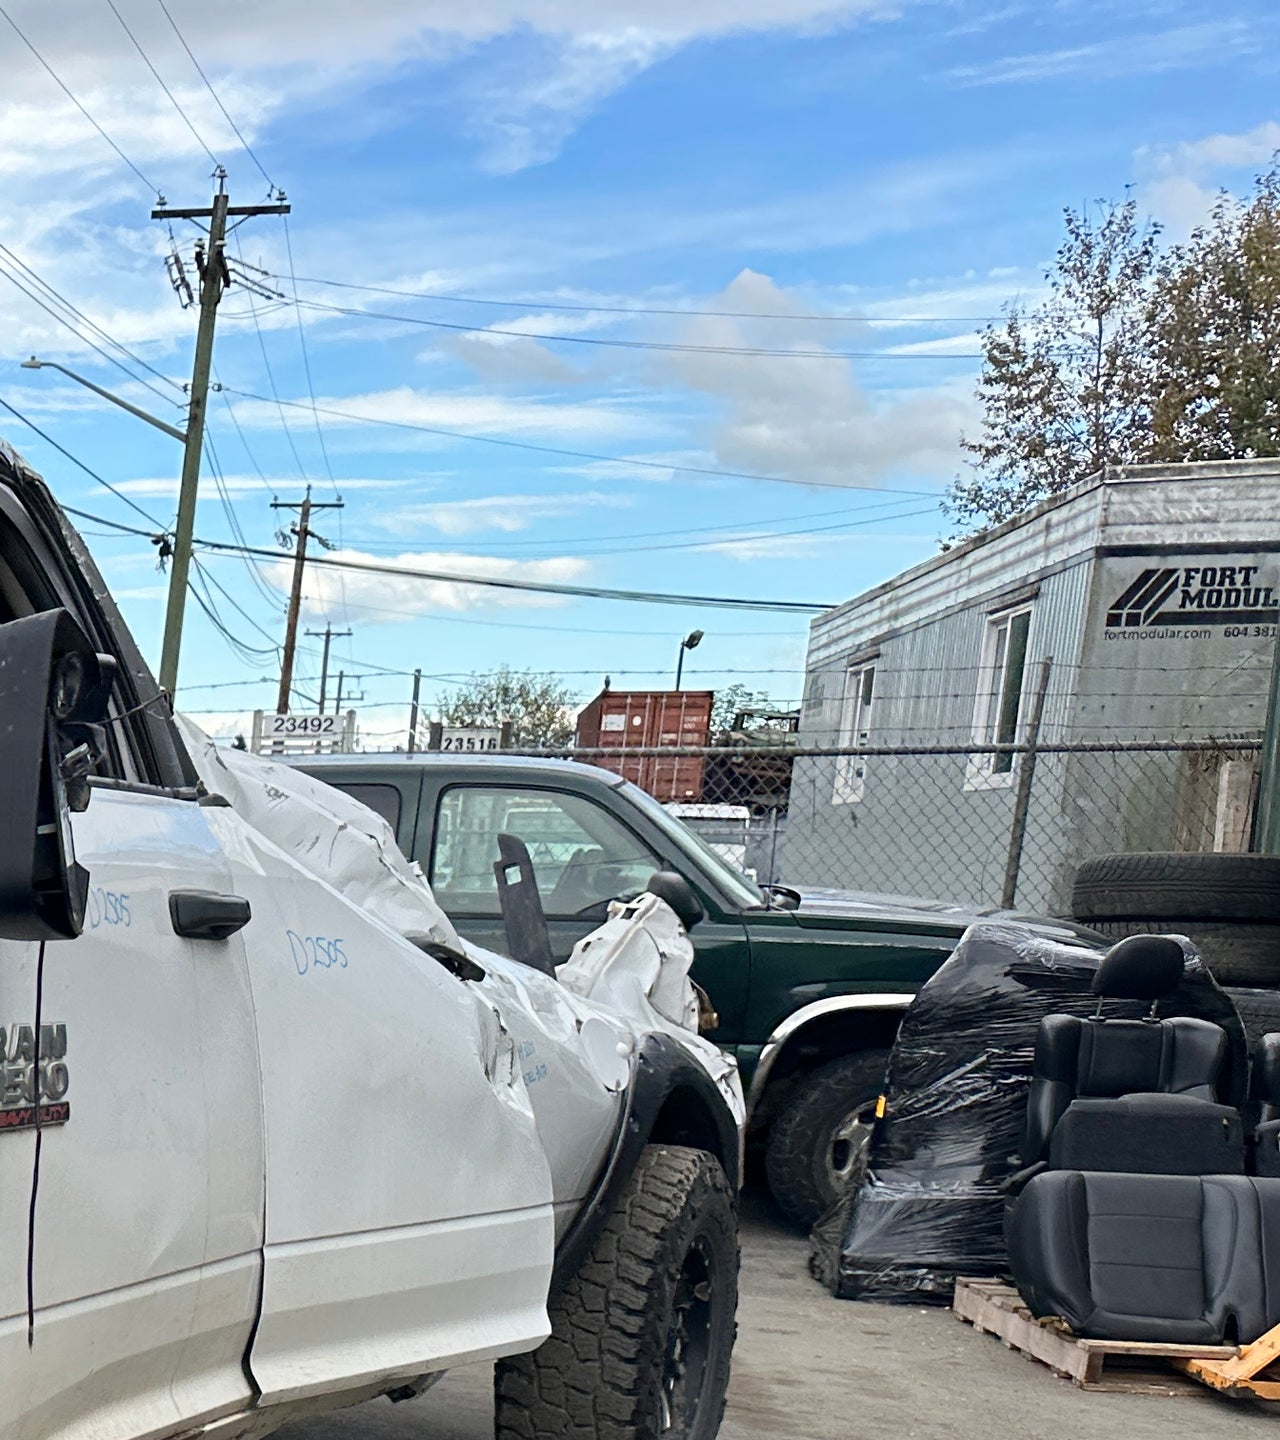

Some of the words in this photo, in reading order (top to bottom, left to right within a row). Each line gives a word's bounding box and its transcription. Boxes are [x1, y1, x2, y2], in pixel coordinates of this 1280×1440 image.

[1181, 566, 1259, 588] FORT
[1104, 627, 1211, 641] fortmodular.com
[273, 717, 335, 733] 23492
[444, 737, 498, 752] 23516
[286, 929, 348, 975] D2505
